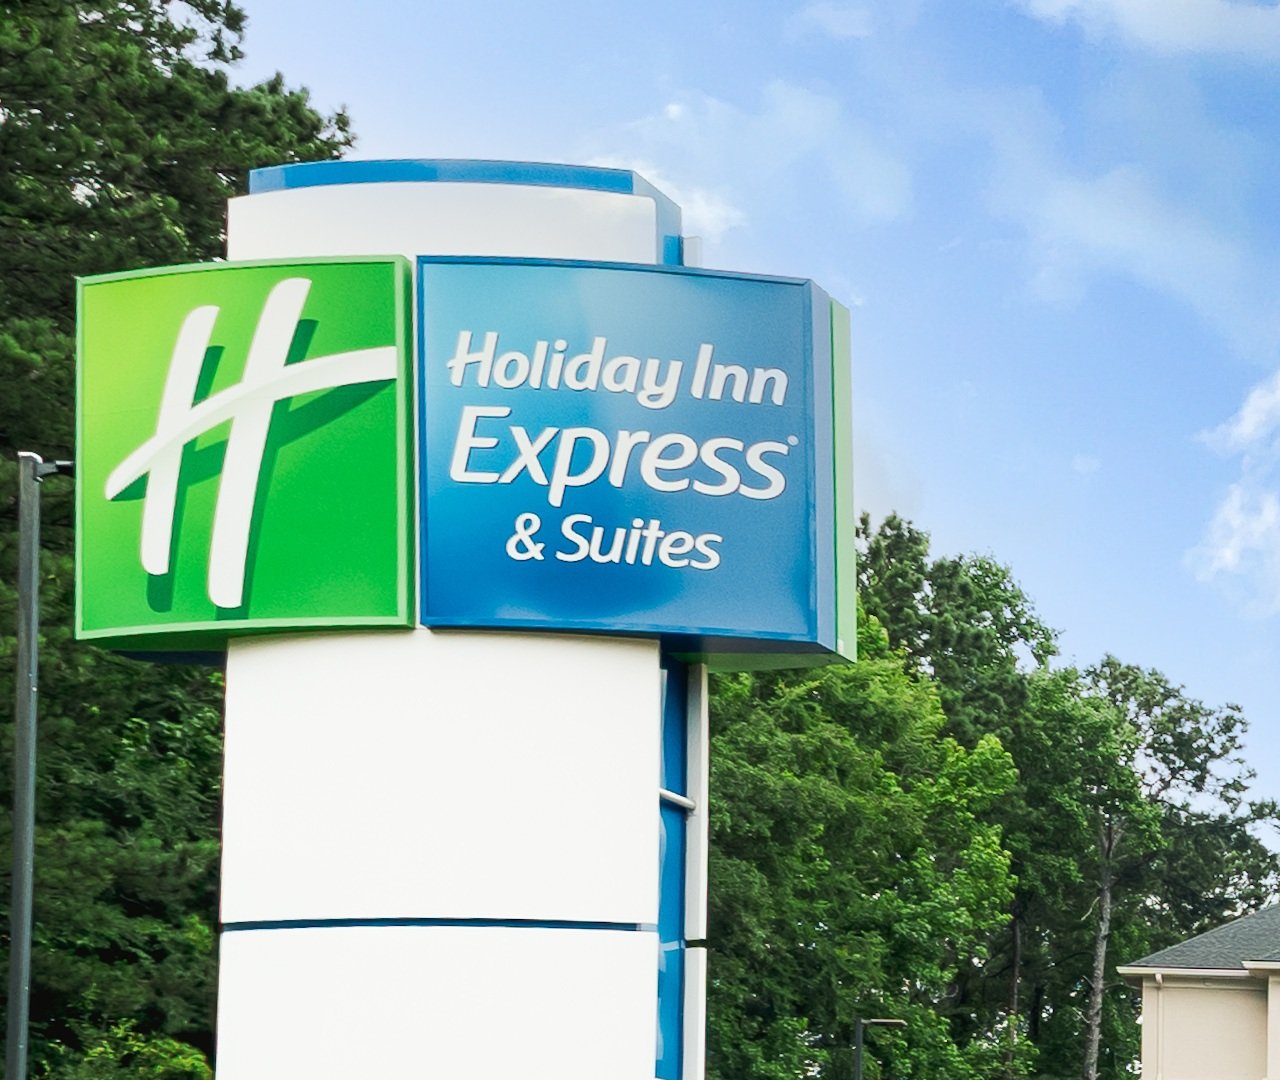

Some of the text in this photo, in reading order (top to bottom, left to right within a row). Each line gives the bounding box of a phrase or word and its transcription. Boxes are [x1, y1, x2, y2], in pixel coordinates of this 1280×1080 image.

[447, 330, 788, 409] Holiday Inn
[450, 405, 790, 507] Express
[506, 513, 723, 570] & Suites
